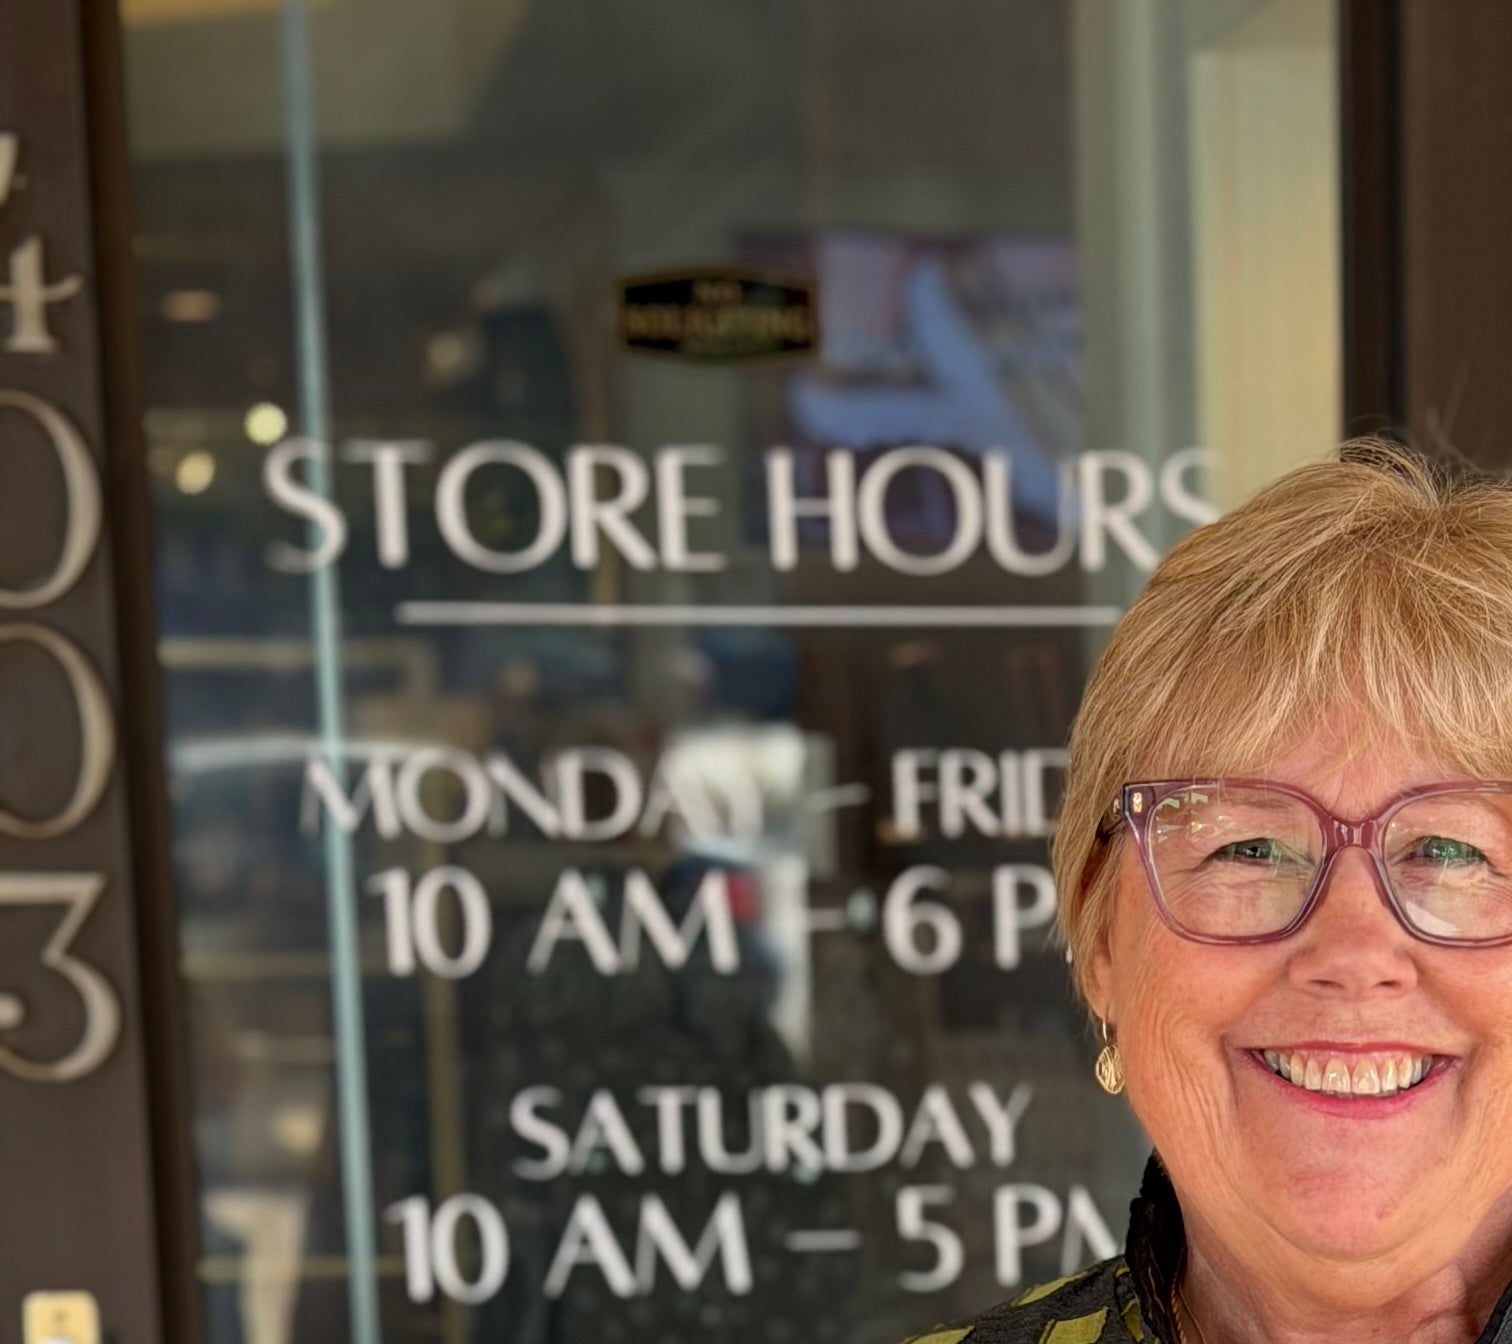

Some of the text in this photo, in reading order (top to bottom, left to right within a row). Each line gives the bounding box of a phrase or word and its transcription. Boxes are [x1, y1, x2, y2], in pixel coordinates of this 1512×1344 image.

[264, 438, 727, 573] STORE
[367, 865, 492, 980] 10
[526, 867, 740, 976] AM
[882, 864, 963, 976] 6
[992, 862, 1060, 972] P
[508, 1081, 1034, 1181] SATURDAY
[384, 1192, 510, 1305] 10
[543, 1191, 753, 1299] AM
[895, 1184, 964, 1293] 5
